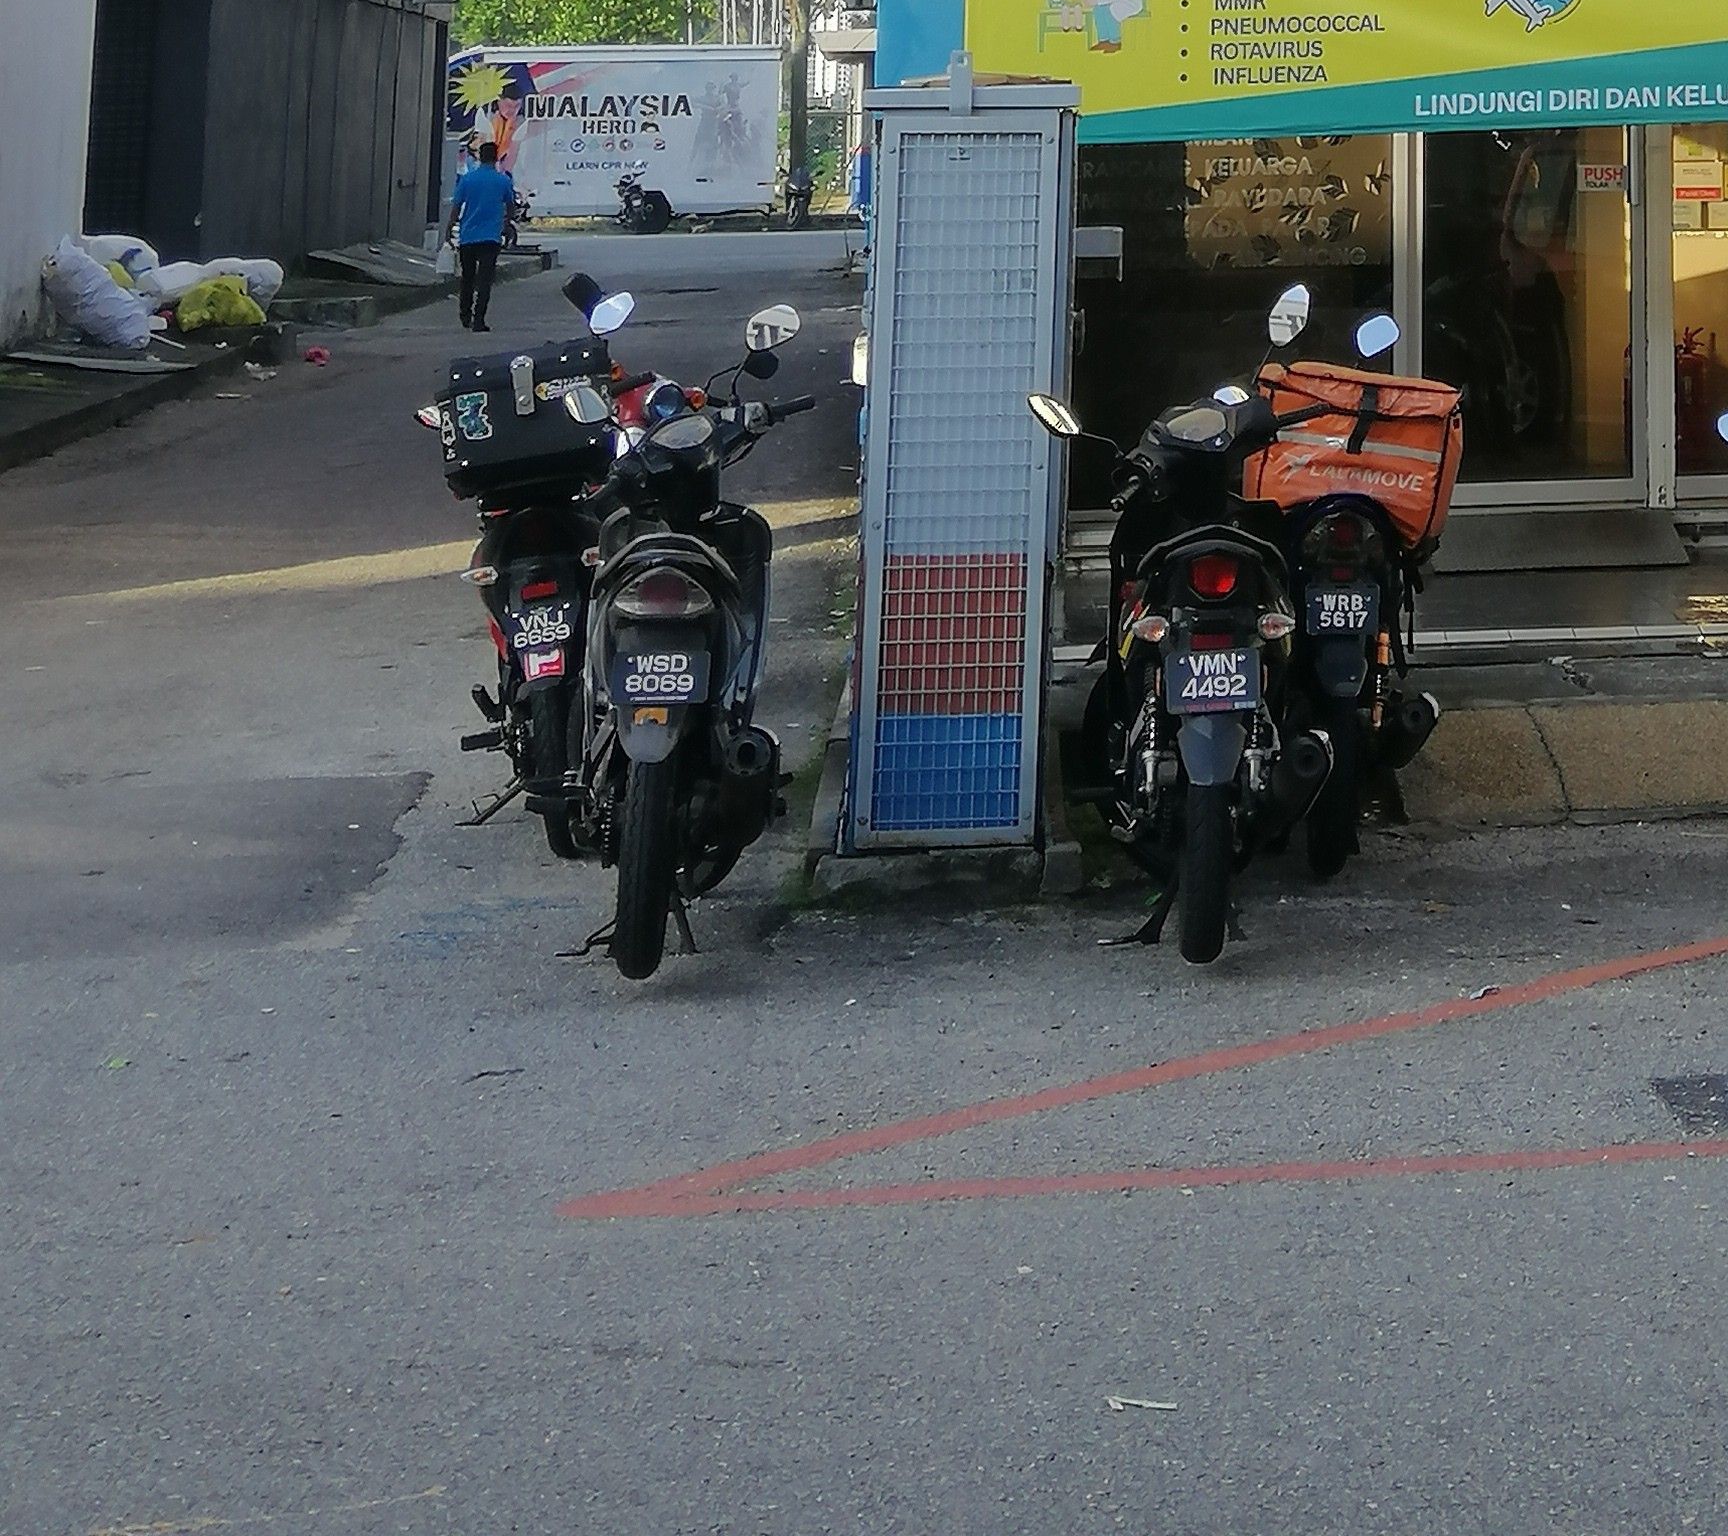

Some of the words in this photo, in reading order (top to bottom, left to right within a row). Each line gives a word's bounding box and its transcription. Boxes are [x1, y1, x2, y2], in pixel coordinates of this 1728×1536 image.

[1210, 14, 1386, 36] PNEUMOCOCCAL
[1210, 40, 1324, 61] ROTAVIRUS
[1213, 65, 1328, 86] INFLUENZA
[525, 94, 693, 119] MALAYSIA
[1414, 89, 1543, 117] LINDUNGI
[1548, 88, 1600, 113] DIRI
[1605, 86, 1666, 111] DAN
[581, 120, 636, 135] HERO
[1205, 155, 1314, 177] KELUARGA
[1583, 167, 1624, 181] PUSH
[1323, 593, 1364, 611] WRB
[519, 610, 563, 632] VNJ
[1319, 610, 1368, 628] 5617
[513, 622, 571, 649] 6659
[636, 653, 689, 674] WSD
[1188, 652, 1237, 677] VMN
[624, 673, 694, 693] 8069
[1181, 674, 1247, 700] 4492
